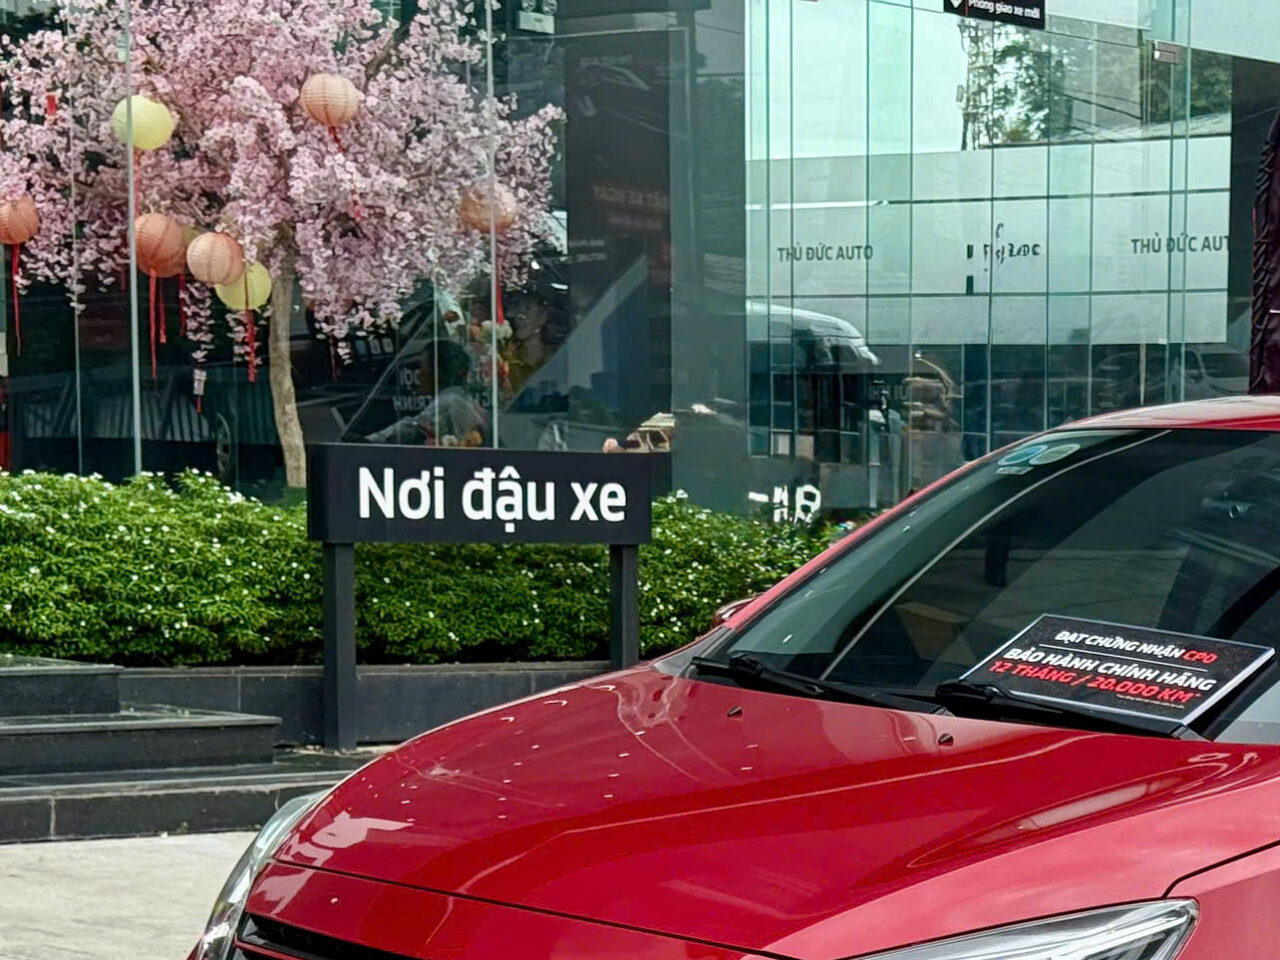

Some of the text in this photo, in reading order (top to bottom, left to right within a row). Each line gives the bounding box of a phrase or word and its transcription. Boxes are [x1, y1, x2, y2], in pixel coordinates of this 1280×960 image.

[777, 242, 874, 262] THỦ ĐỨC AUTO
[1130, 232, 1161, 254] THỦ
[1166, 232, 1198, 252] ĐỨC
[359, 465, 627, 533] Nơi đậu xe
[1054, 631, 1088, 644] ĐẠT
[1137, 643, 1186, 659] NHẬN
[1183, 650, 1219, 664] CPO
[989, 661, 1013, 673] 12
[1011, 664, 1078, 683] THÁNG
[1087, 676, 1160, 698] 20.000
[1003, 646, 1218, 691] BẢO HÀNH CHÍNH HÃNG
